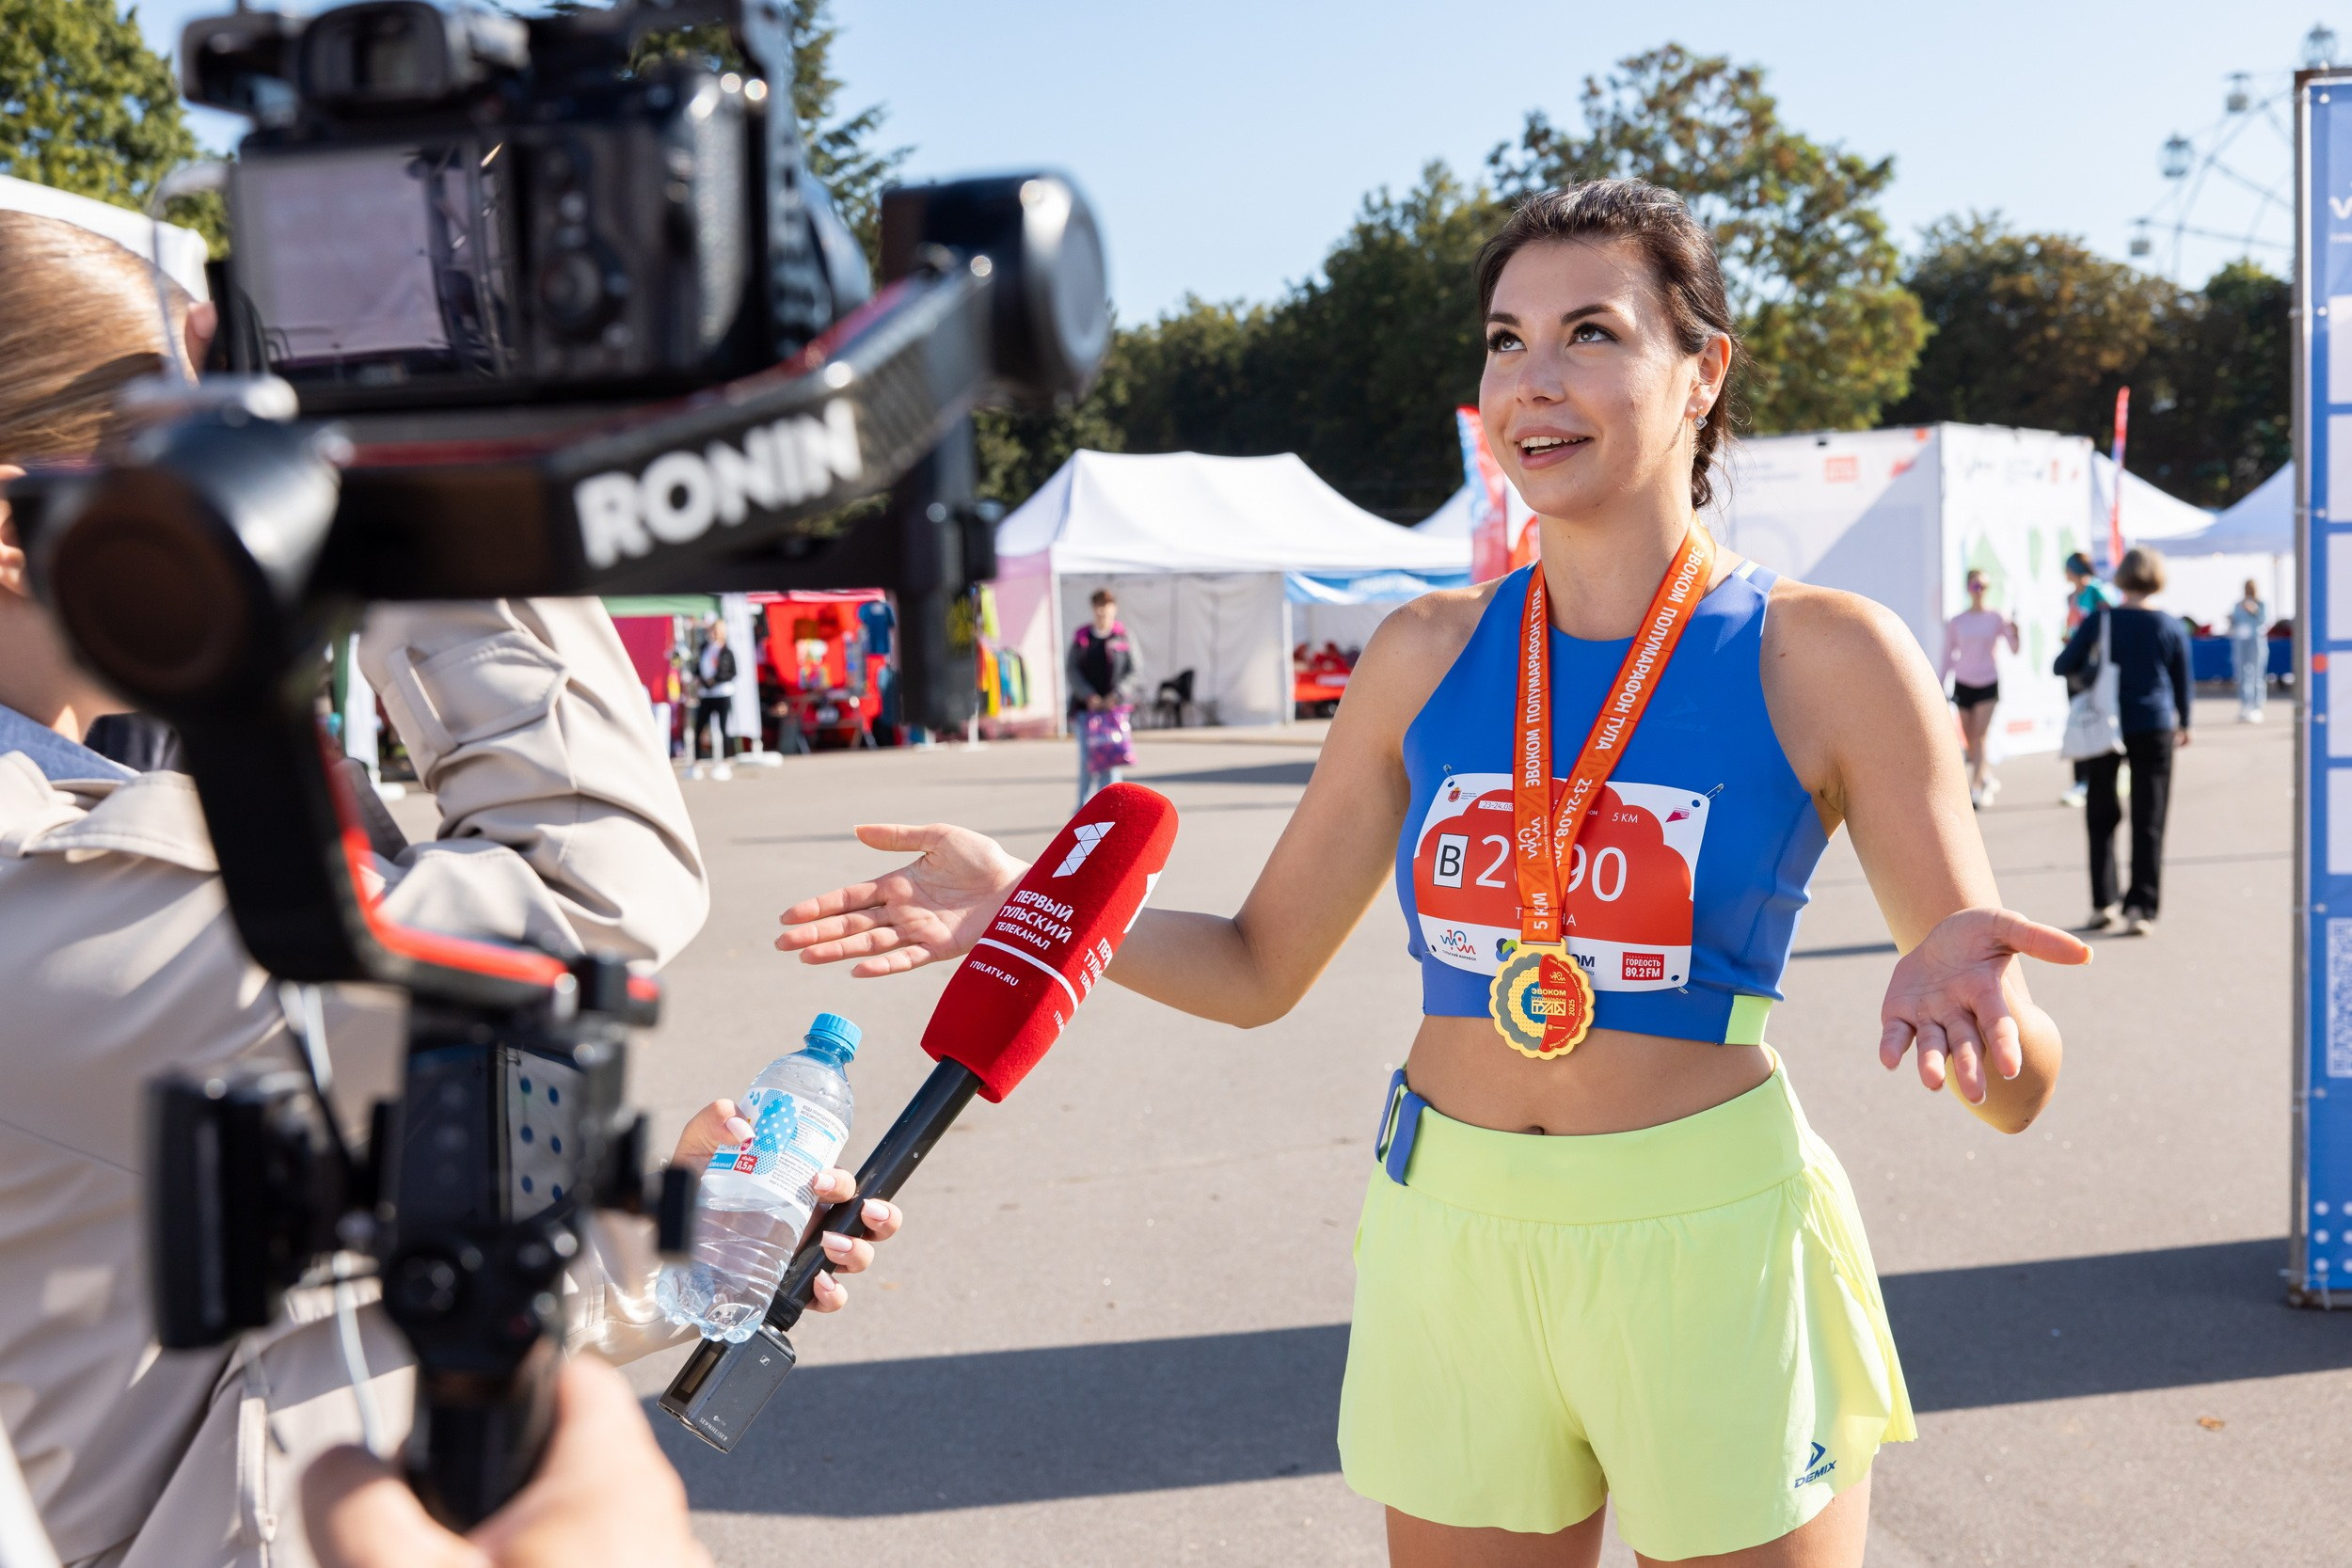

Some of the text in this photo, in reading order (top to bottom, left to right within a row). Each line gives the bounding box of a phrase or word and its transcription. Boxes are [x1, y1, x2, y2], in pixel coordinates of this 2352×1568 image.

[573, 397, 863, 569] RONIN
[1596, 546, 1705, 750] ЭВОКОМ ПОЛУМАРАФОН ТУЛА
[1525, 585, 1542, 787] ЭВОКОМ ПОЛУМАРАФОН ТУЛА
[1612, 814, 1619, 822] 5
[1475, 834, 1628, 902] 290
[1013, 890, 1074, 923] ПЕРВЫЙ
[994, 921, 1052, 951] ТЕЛЕКАНАЛ
[999, 905, 1073, 944] ТУЛЬСКИЙ
[1534, 920, 1548, 930] 5
[970, 960, 1019, 987] 1TULATV.RU
[1625, 967, 1661, 977] 89.2 FM
[1626, 958, 1661, 967] ГОРДОСТЬ
[1531, 988, 1566, 997] ЭВОКОМ
[699, 1417, 728, 1442] SENNHEISER
[1794, 1460, 1837, 1488] DEMIX
